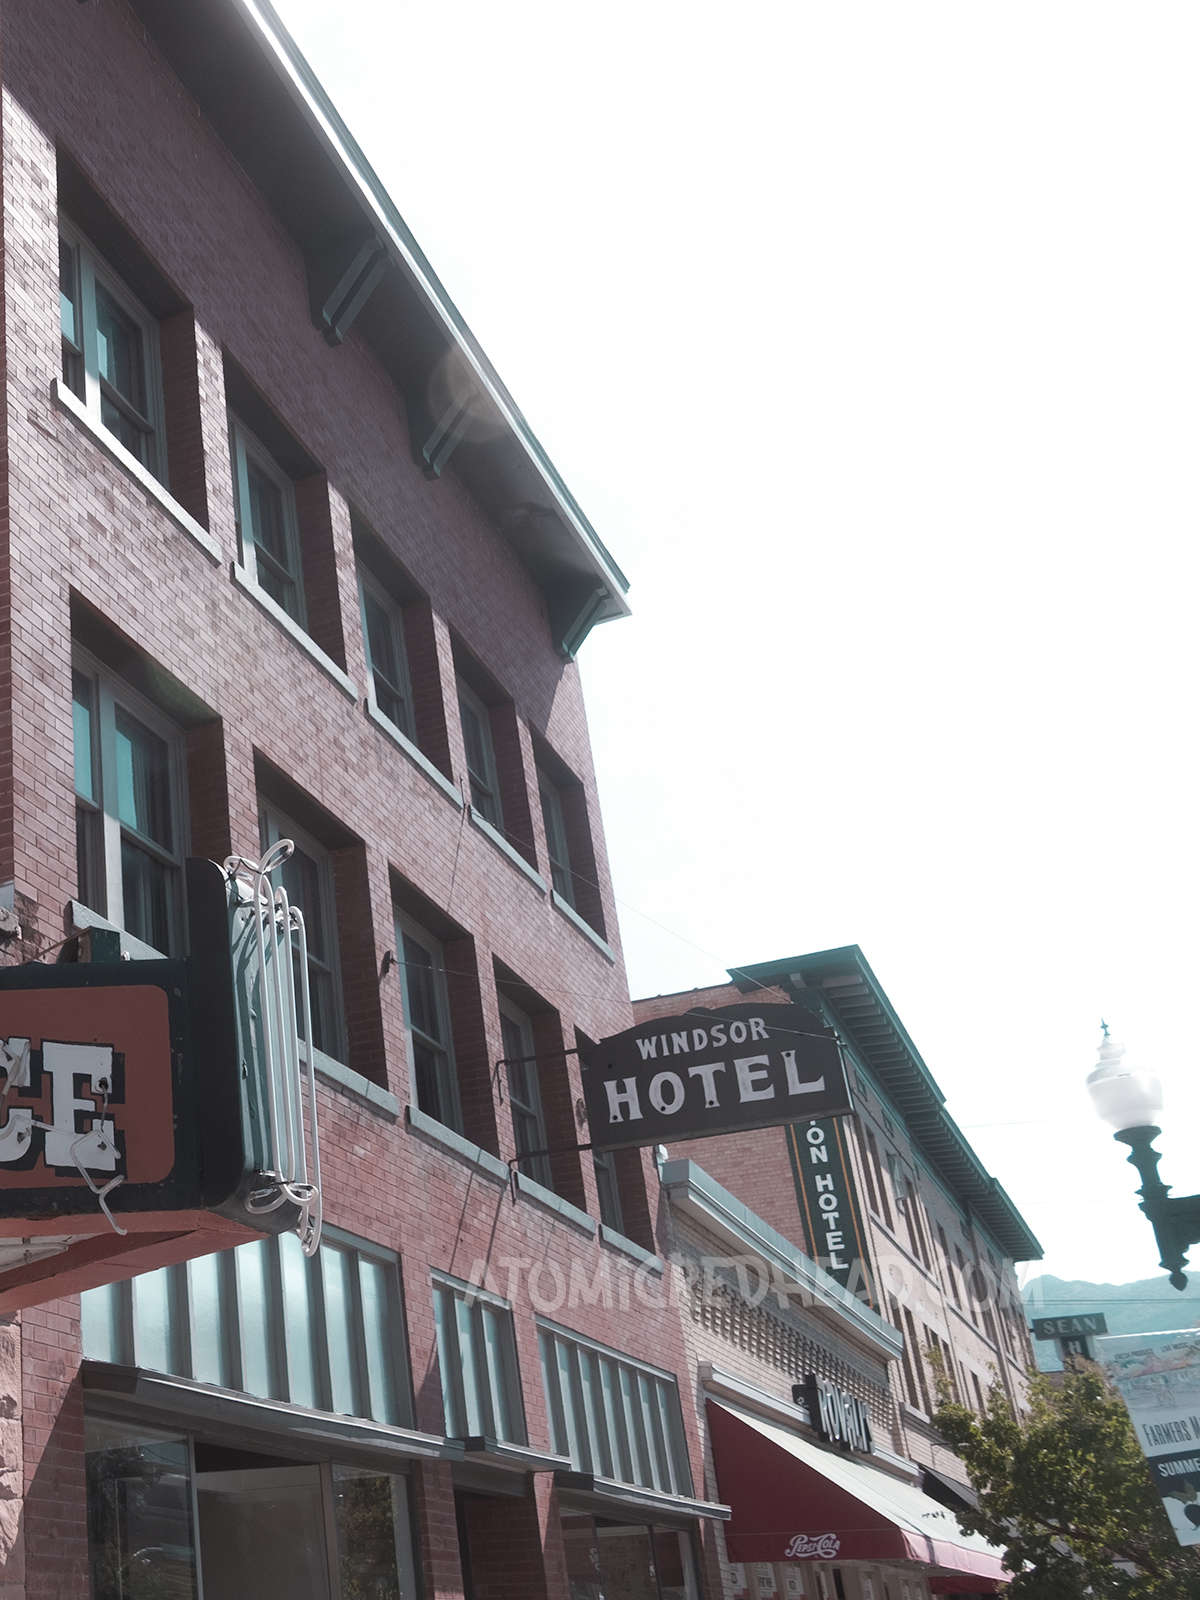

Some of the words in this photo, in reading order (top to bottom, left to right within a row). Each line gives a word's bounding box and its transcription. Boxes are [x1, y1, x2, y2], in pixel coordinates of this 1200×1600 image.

[635, 1016, 770, 1061] WINDSOR
[604, 1049, 826, 1123] HOTEL
[814, 1173, 849, 1270] HOTEL
[1042, 1317, 1098, 1335] SEAN
[1142, 1420, 1192, 1447] FARMERS
